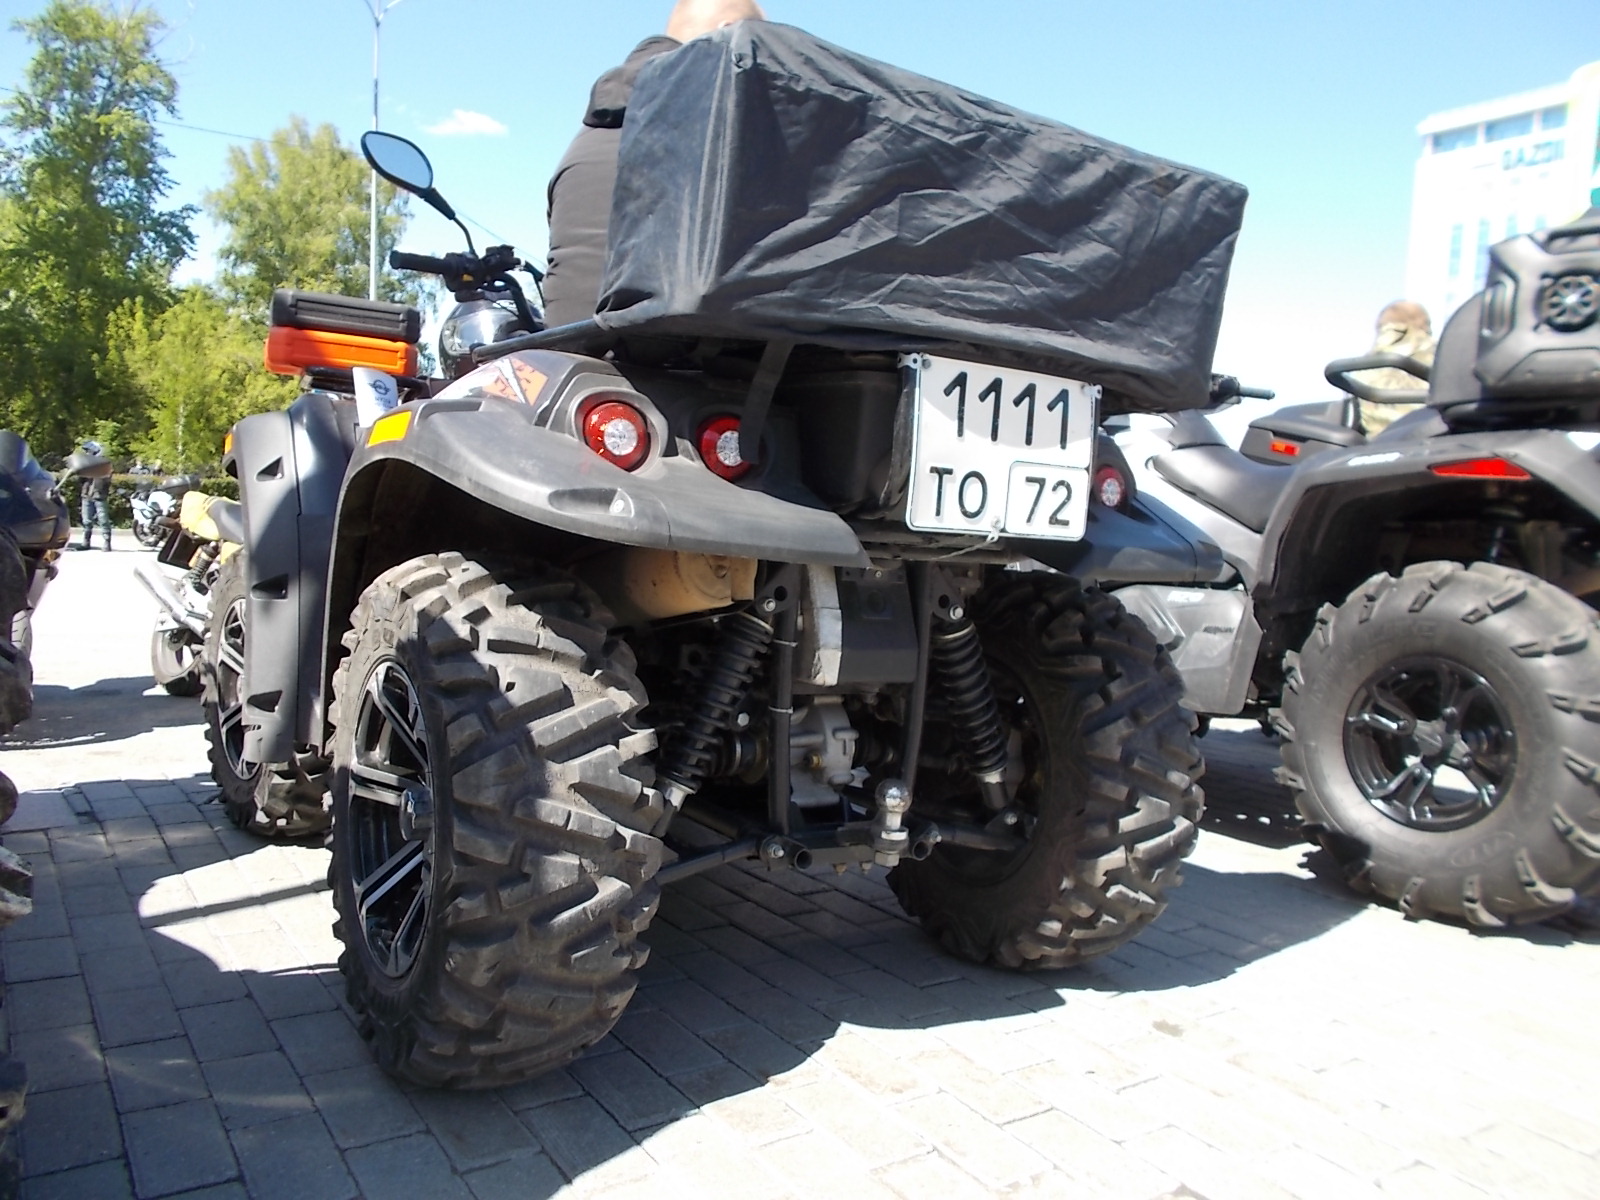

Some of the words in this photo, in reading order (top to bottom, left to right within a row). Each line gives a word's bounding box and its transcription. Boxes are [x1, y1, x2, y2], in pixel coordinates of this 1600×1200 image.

[943, 371, 1069, 450] 1111
[929, 466, 988, 519] TO
[1025, 476, 1073, 526] 72
